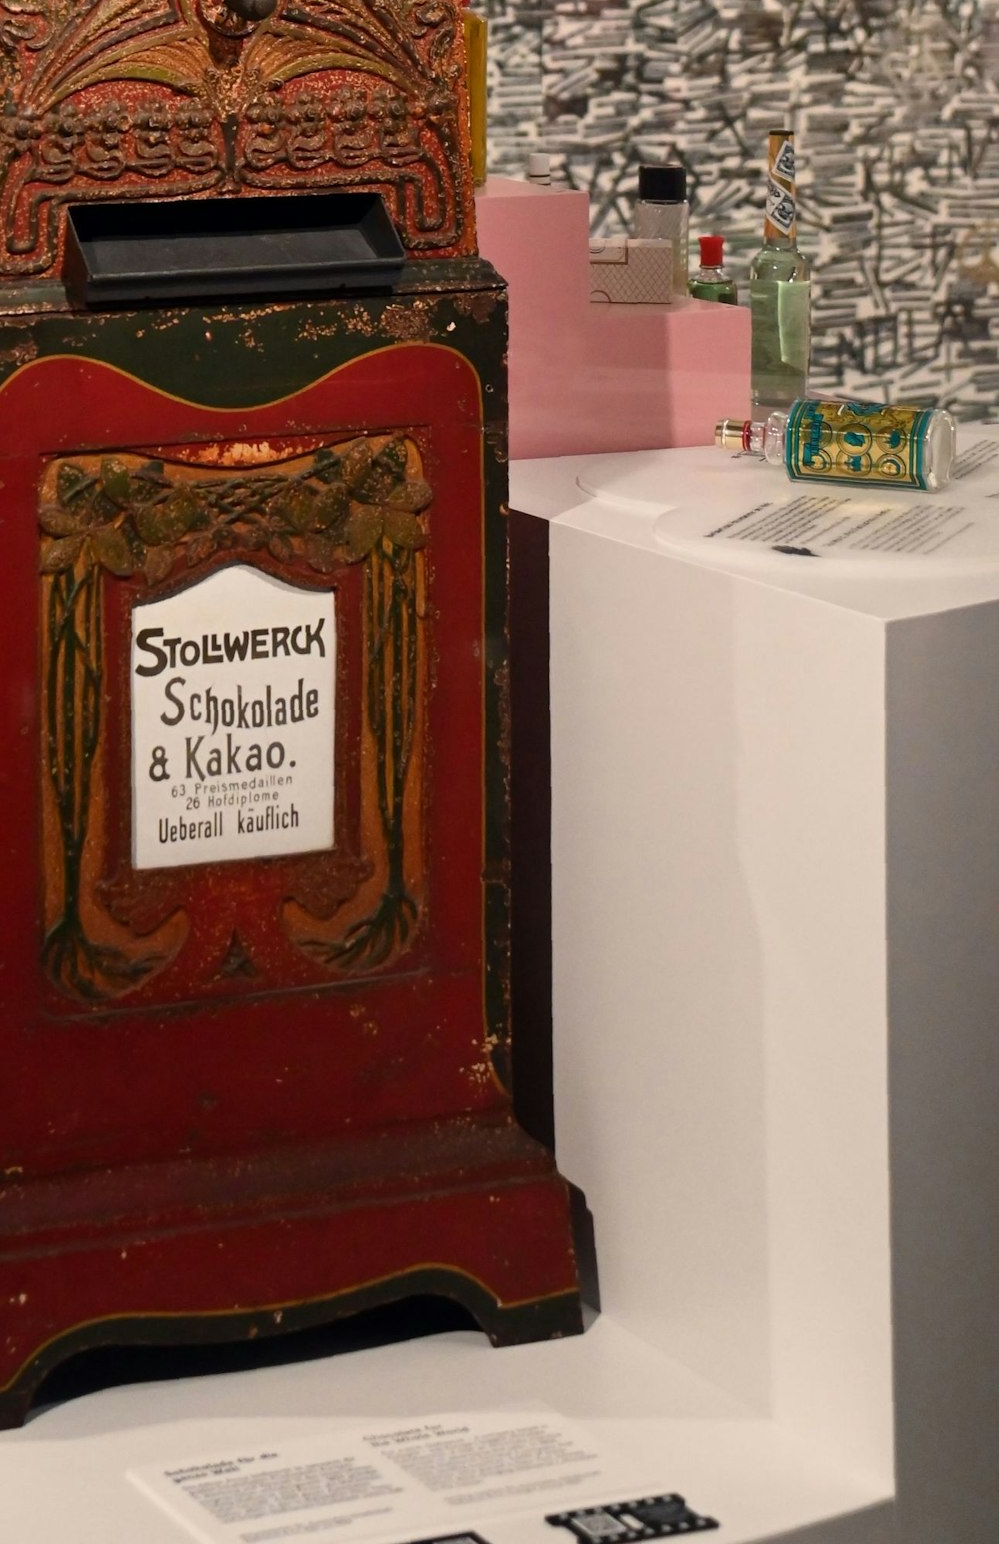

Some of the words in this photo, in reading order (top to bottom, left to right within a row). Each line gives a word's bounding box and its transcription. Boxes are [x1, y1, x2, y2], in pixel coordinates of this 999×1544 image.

[135, 618, 326, 677] STOLLWERCK
[160, 676, 319, 736] Schokolade
[149, 745, 171, 782] &
[185, 733, 296, 782] Kakao.
[171, 784, 186, 798] 63
[194, 774, 293, 795] Preismedaillen
[186, 797, 200, 811] 26
[207, 791, 279, 807] Hofdiplome
[158, 811, 223, 844] Ueberall
[237, 803, 300, 835] käuflich
